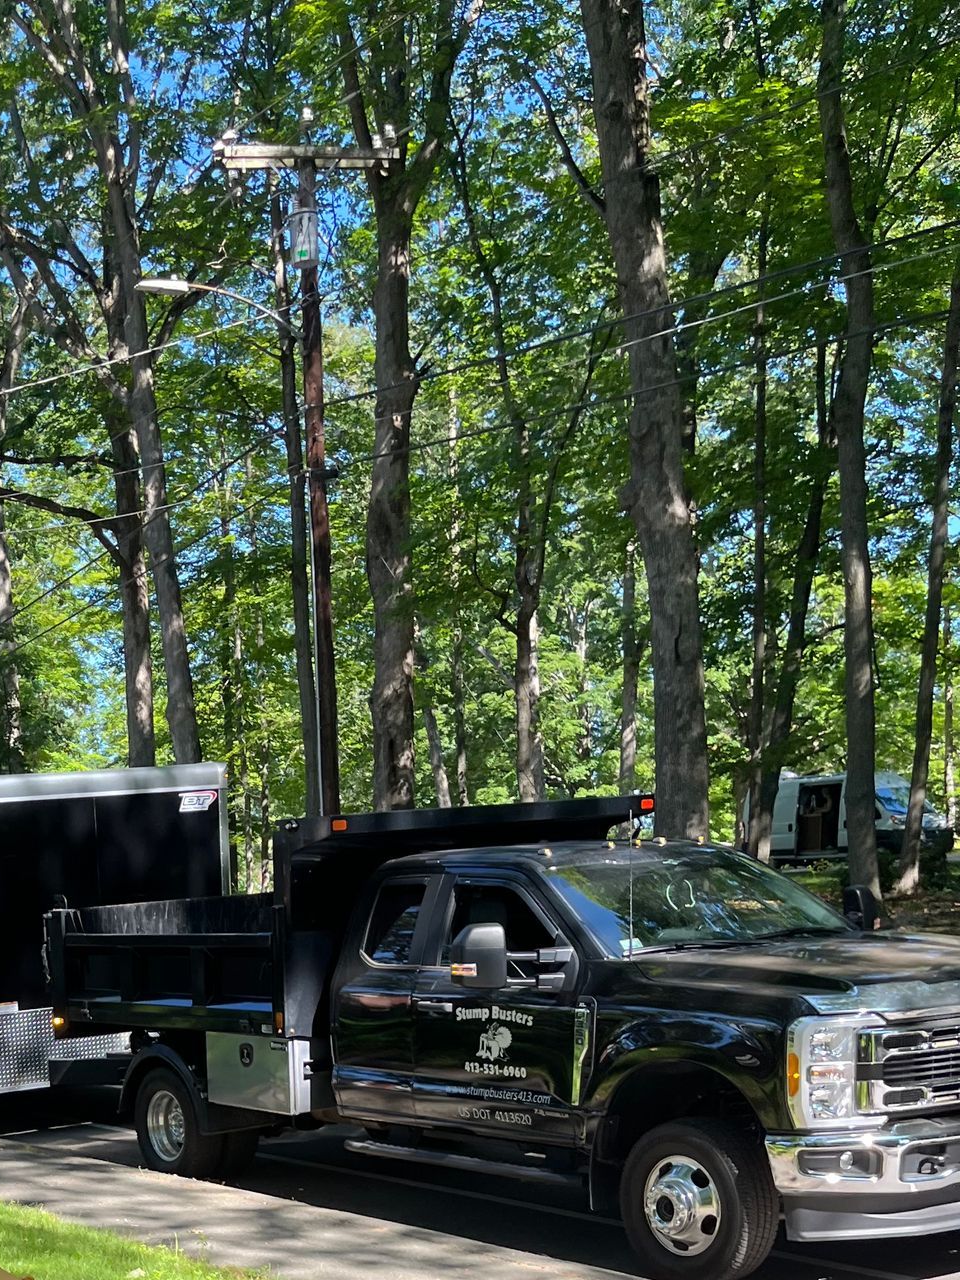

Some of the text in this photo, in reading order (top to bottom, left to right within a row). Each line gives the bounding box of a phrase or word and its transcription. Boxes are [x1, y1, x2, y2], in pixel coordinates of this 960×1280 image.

[456, 1005, 534, 1026] Stump Busters
[464, 1061, 527, 1079] 413-531-6960
[446, 1086, 551, 1104] www.stumpbusters413.com
[458, 1107, 471, 1118] US
[472, 1107, 491, 1120] DOT
[494, 1110, 533, 1126] 4113620
